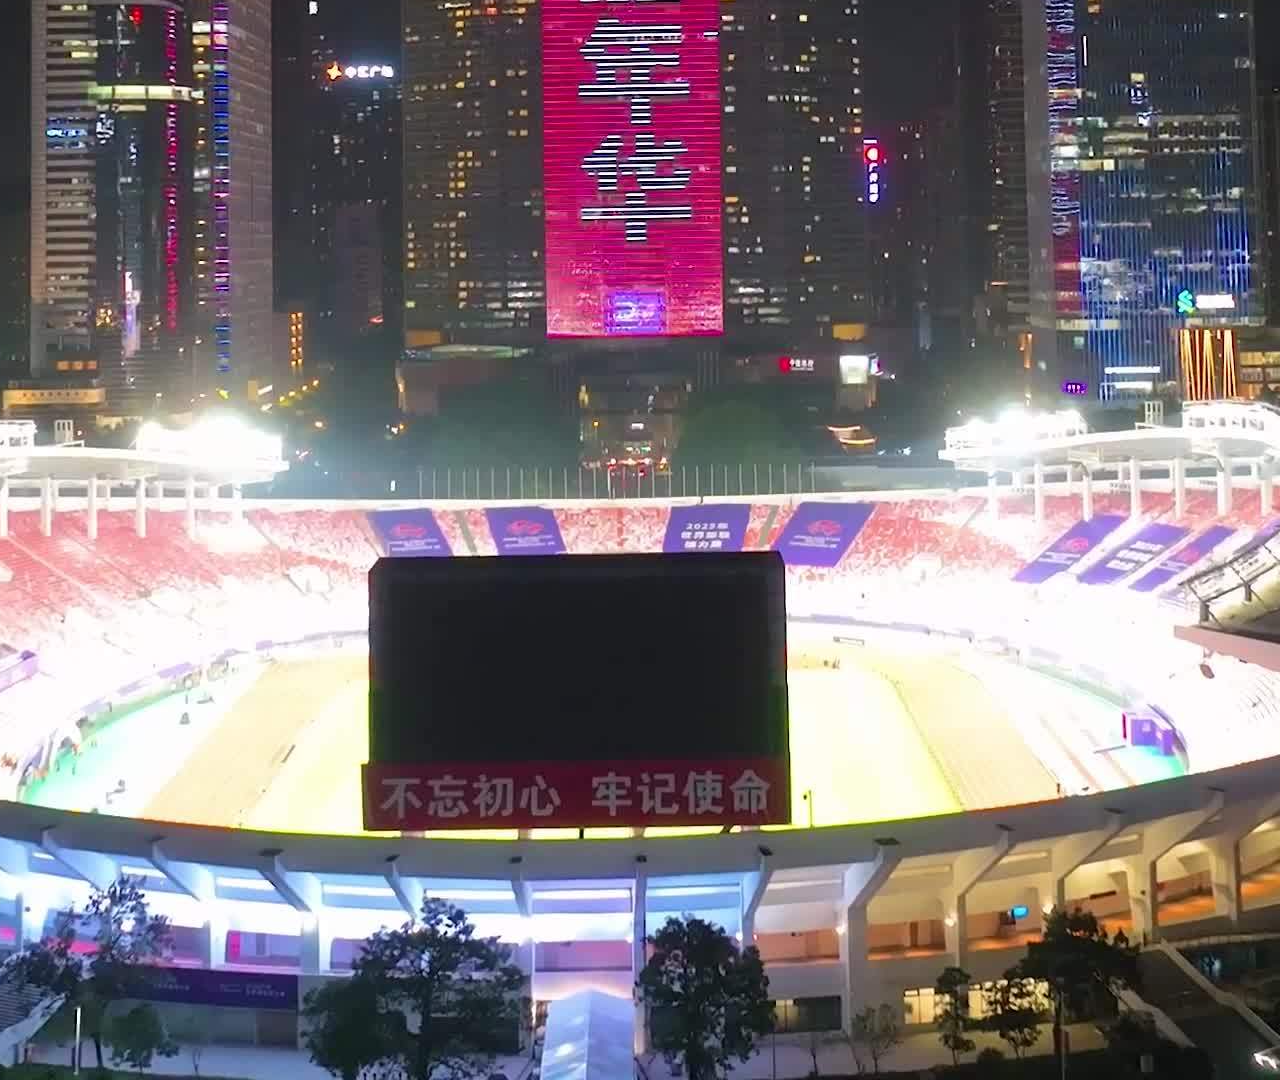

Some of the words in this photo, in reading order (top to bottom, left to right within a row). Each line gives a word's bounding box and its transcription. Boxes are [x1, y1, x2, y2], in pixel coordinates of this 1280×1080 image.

[380, 774, 561, 820] 不忘初心
[591, 768, 772, 817] 牢记使命
